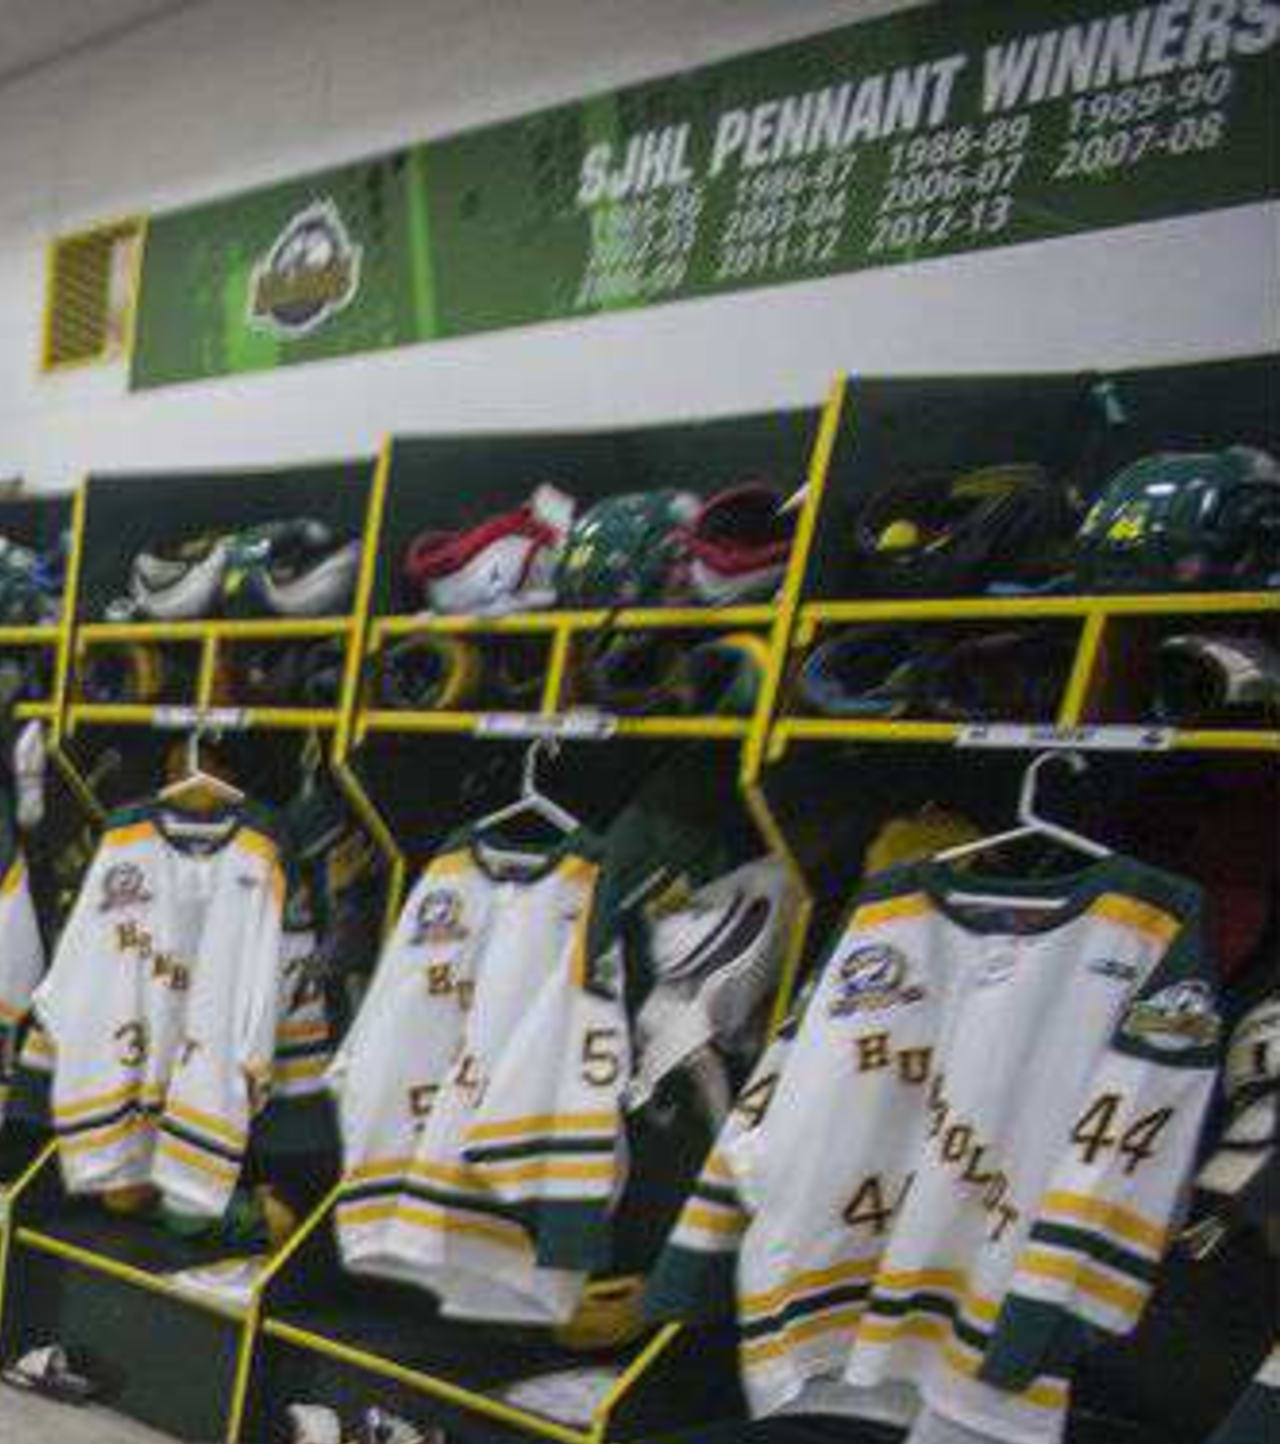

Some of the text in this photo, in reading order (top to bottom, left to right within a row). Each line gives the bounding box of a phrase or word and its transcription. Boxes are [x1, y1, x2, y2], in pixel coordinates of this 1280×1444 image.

[578, 0, 1280, 205] SJHL PENNANT WINNERS
[888, 114, 1031, 174] 1988-89
[1069, 66, 1233, 133] 1989-90
[881, 152, 1024, 212] 2006-07
[1053, 113, 1226, 179] 2007-08
[867, 196, 1014, 254] 2012-13
[582, 1027, 620, 1088] 5
[857, 1029, 1020, 1242] HUOLDT
[1069, 1091, 1176, 1178] 44
